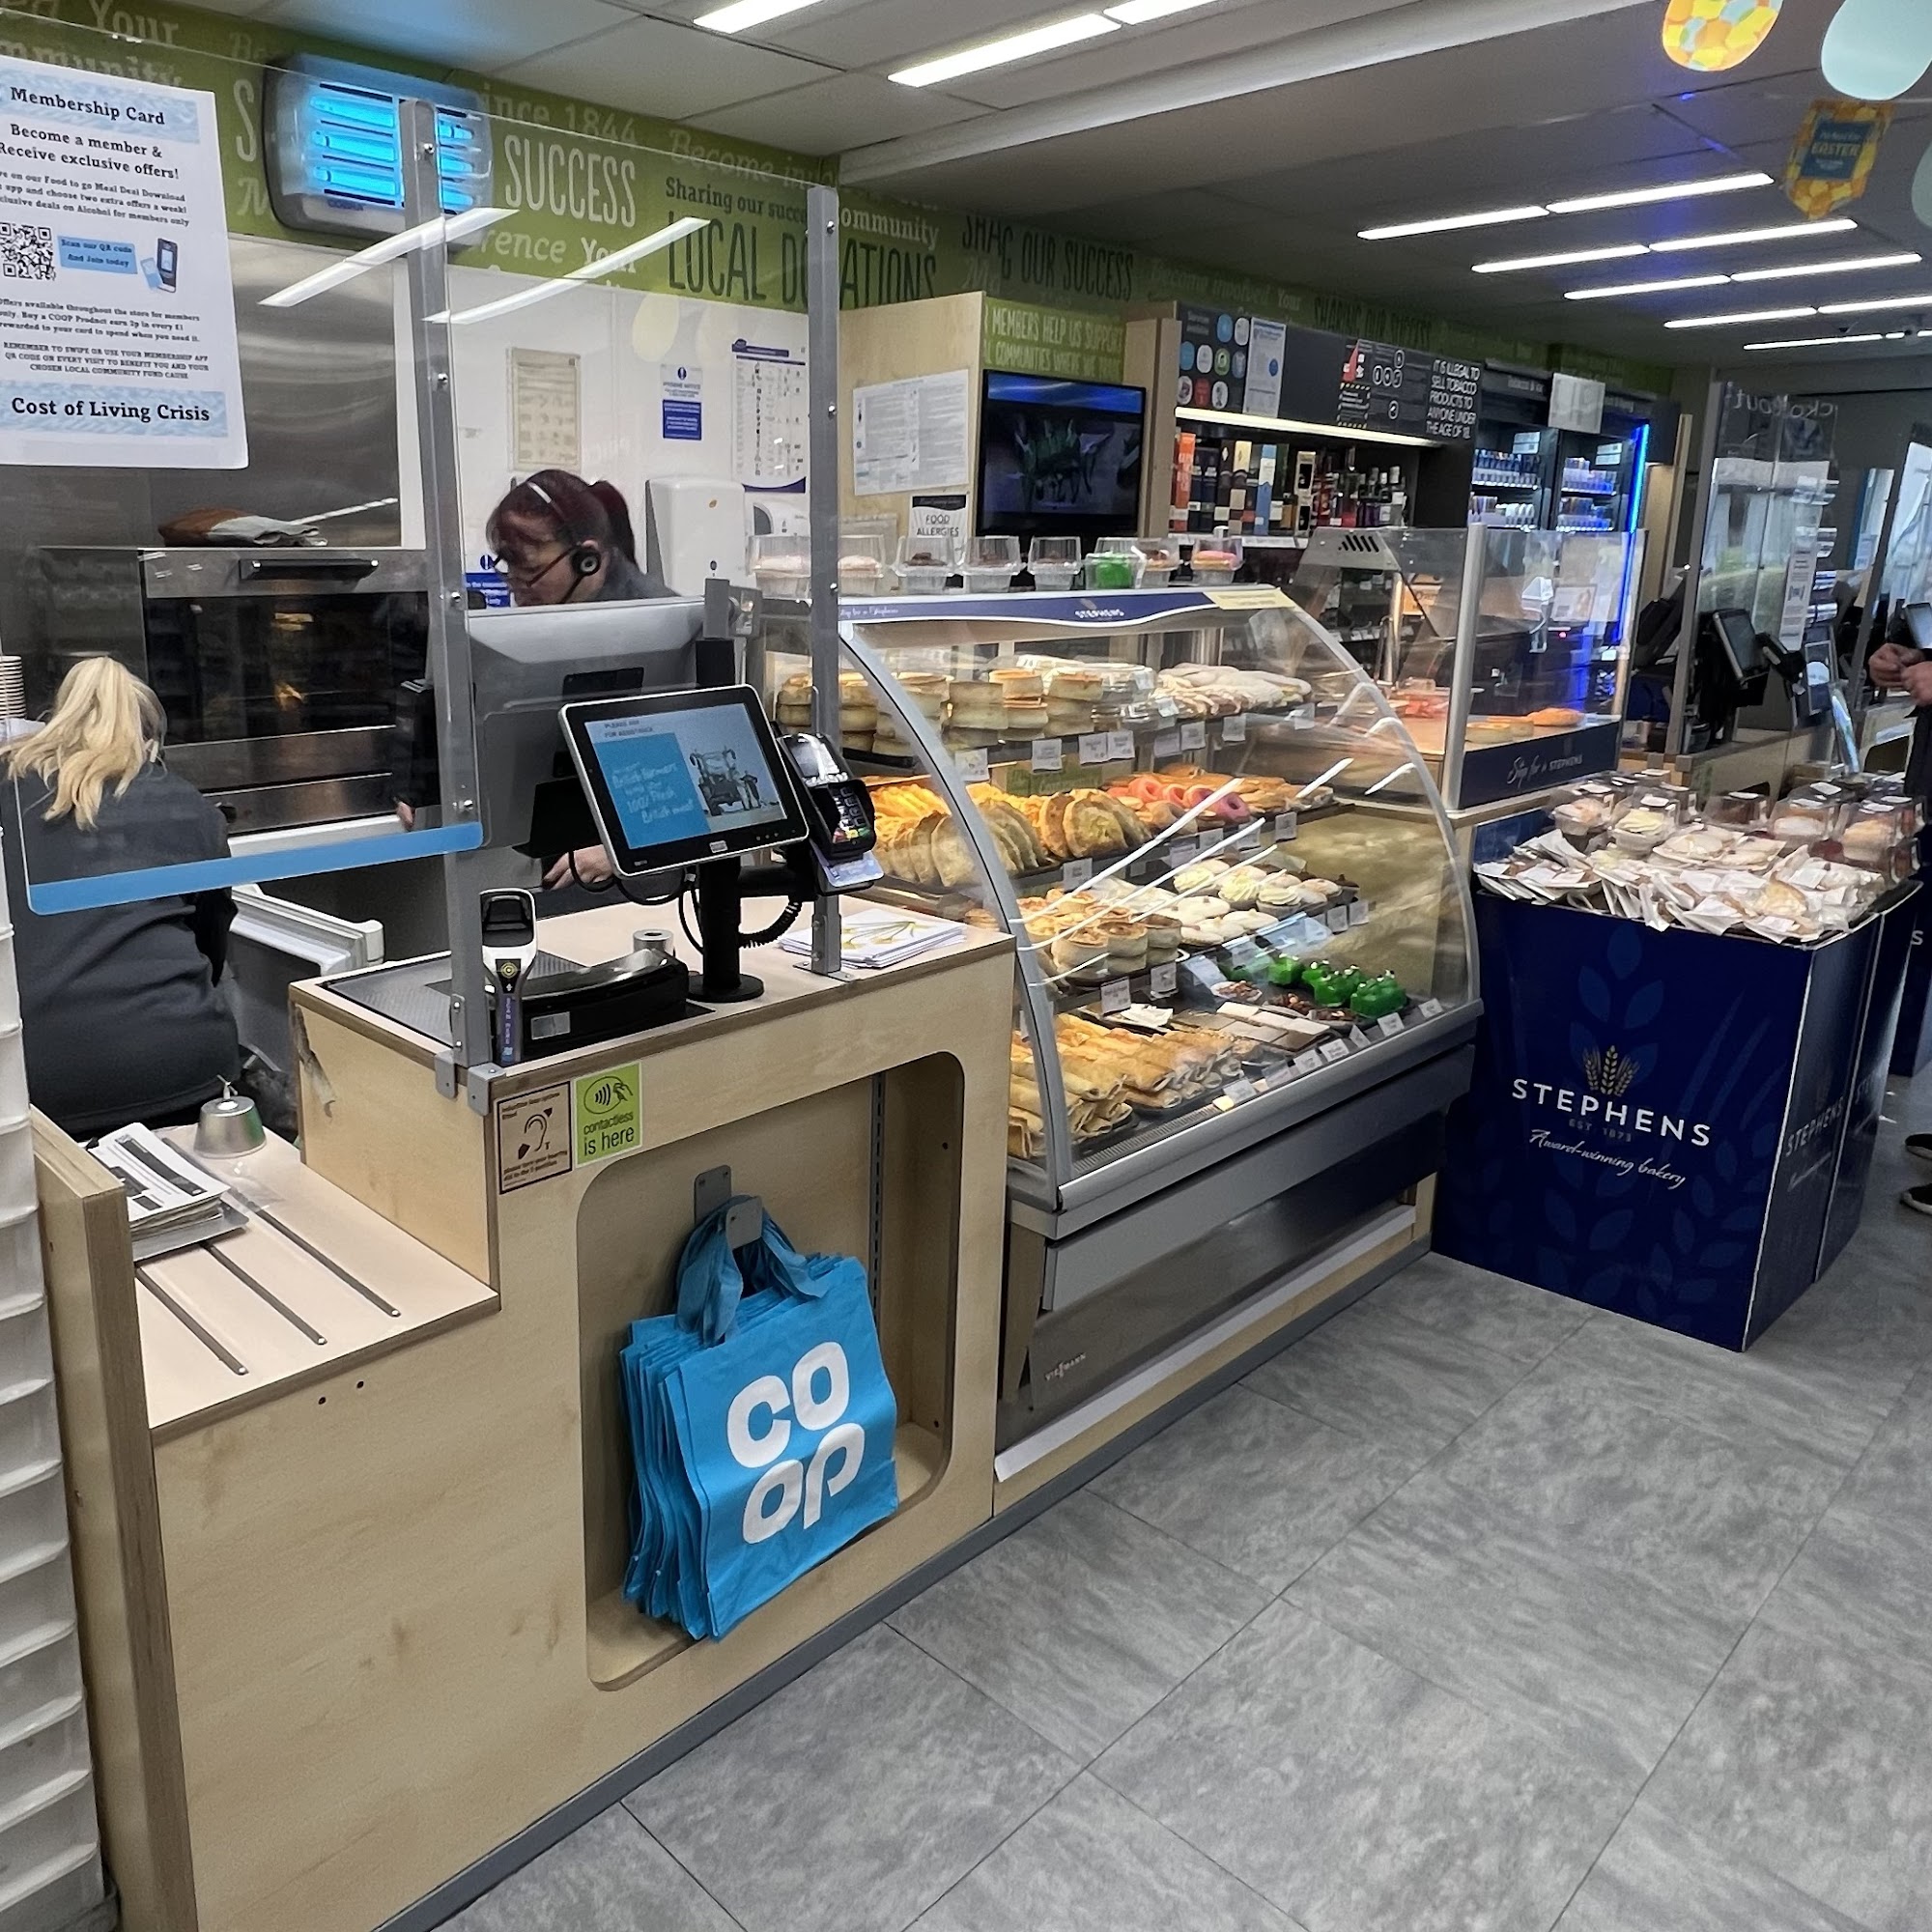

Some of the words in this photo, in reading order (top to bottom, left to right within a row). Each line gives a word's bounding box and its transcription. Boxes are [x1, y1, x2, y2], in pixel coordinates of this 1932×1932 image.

[10, 86, 120, 122] Membership
[126, 106, 165, 126] Card
[484, 83, 551, 123] ince
[10, 123, 71, 144] Become
[75, 136, 84, 146] a
[88, 137, 148, 156] member
[152, 146, 163, 158] &
[0, 142, 56, 162] Receive
[61, 154, 130, 173] exclusive
[134, 162, 180, 180] offers!
[44, 175, 68, 186] Food
[70, 179, 79, 187] to
[95, 182, 118, 193] Meal
[142, 188, 185, 202] Download
[46, 188, 78, 200] choose
[80, 193, 99, 202] two
[99, 197, 125, 206] extra
[127, 200, 151, 210] offers
[503, 134, 637, 229] SUCCESS
[666, 176, 732, 214] Sharing
[737, 195, 764, 213] our
[0, 195, 33, 207] clusive
[36, 200, 60, 211] deals
[77, 204, 111, 216] Alcohol
[113, 209, 127, 218] for
[128, 212, 169, 224] members
[170, 217, 190, 228] only
[839, 207, 940, 251] ommunity
[99, 243, 112, 252] QR
[668, 211, 767, 301] LOCAL
[1021, 231, 1056, 288] OUR
[1065, 240, 1133, 302] SUCCESS
[992, 307, 1039, 341] MEMBERS
[1042, 315, 1066, 345] HELP
[1069, 320, 1083, 349] US
[12, 397, 57, 416] Cost
[65, 401, 85, 416] of
[89, 401, 152, 423] Living
[156, 404, 211, 422] Crisis
[916, 526, 959, 538] ALLERGIES
[925, 513, 951, 526] FOOD
[582, 1111, 634, 1136] contactless
[1511, 1077, 1712, 1148] STEPHENS
[1568, 1118, 1593, 1132] EST
[1785, 1095, 1844, 1158] STEPHENS
[583, 1138, 597, 1156] is
[601, 1126, 635, 1152] here
[1528, 1127, 1634, 1178] Award-winning
[1637, 1156, 1687, 1191] bakery
